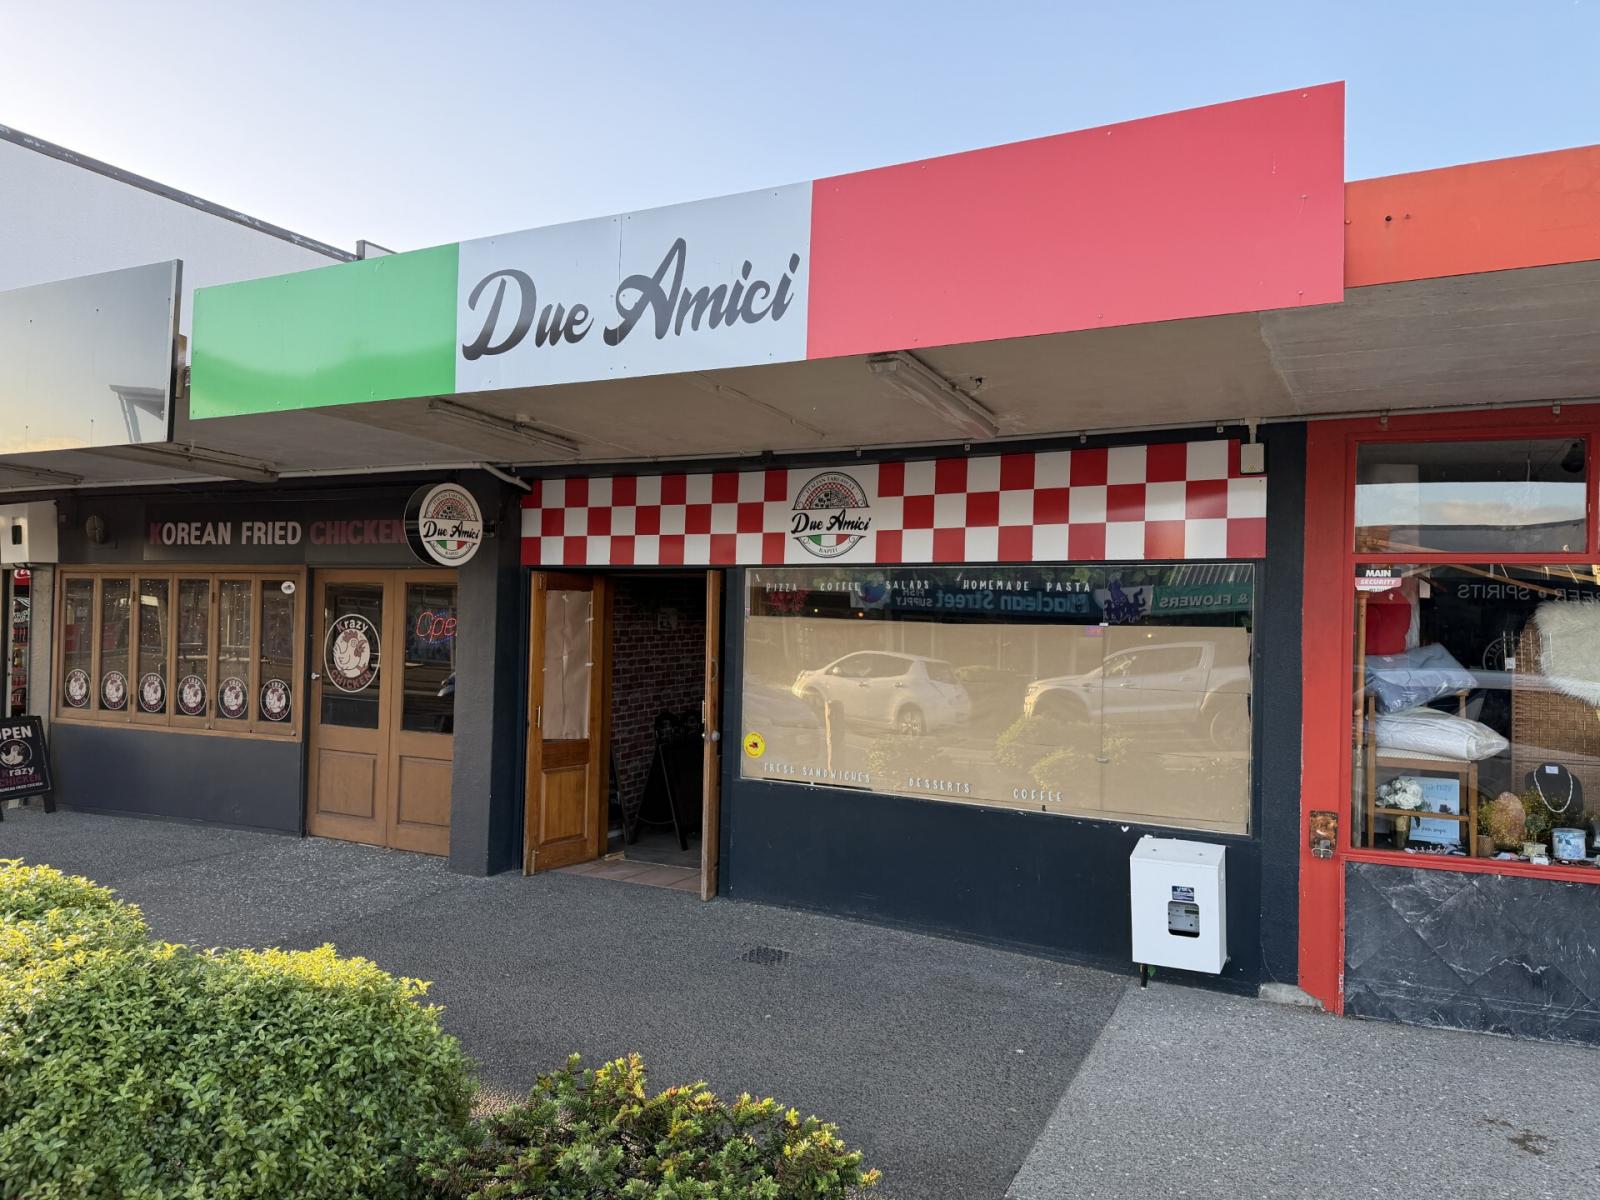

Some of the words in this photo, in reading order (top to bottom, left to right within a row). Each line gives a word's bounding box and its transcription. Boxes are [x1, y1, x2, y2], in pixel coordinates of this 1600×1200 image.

[462, 269, 595, 361] Due
[603, 237, 801, 347] Amici
[423, 521, 448, 538] Due
[450, 521, 481, 539] Amici
[791, 513, 823, 534] Due
[826, 508, 871, 531] Amici
[150, 522, 231, 545] KOREAN
[241, 522, 302, 545] FRIED
[1365, 569, 1392, 577] MAIN
[766, 582, 797, 592] PIZZA
[820, 582, 860, 591] COFFEE
[885, 580, 929, 590] SALADS
[962, 579, 1029, 591] HOMEMADE
[1046, 582, 1090, 592] PASTA
[336, 619, 369, 632] Krazy
[416, 611, 457, 644] Ope
[331, 669, 372, 688] CHICKEN
[802, 766, 871, 783] SANDWICHES
[909, 777, 971, 793] DESSERTS
[1013, 788, 1063, 801] COFFEE
